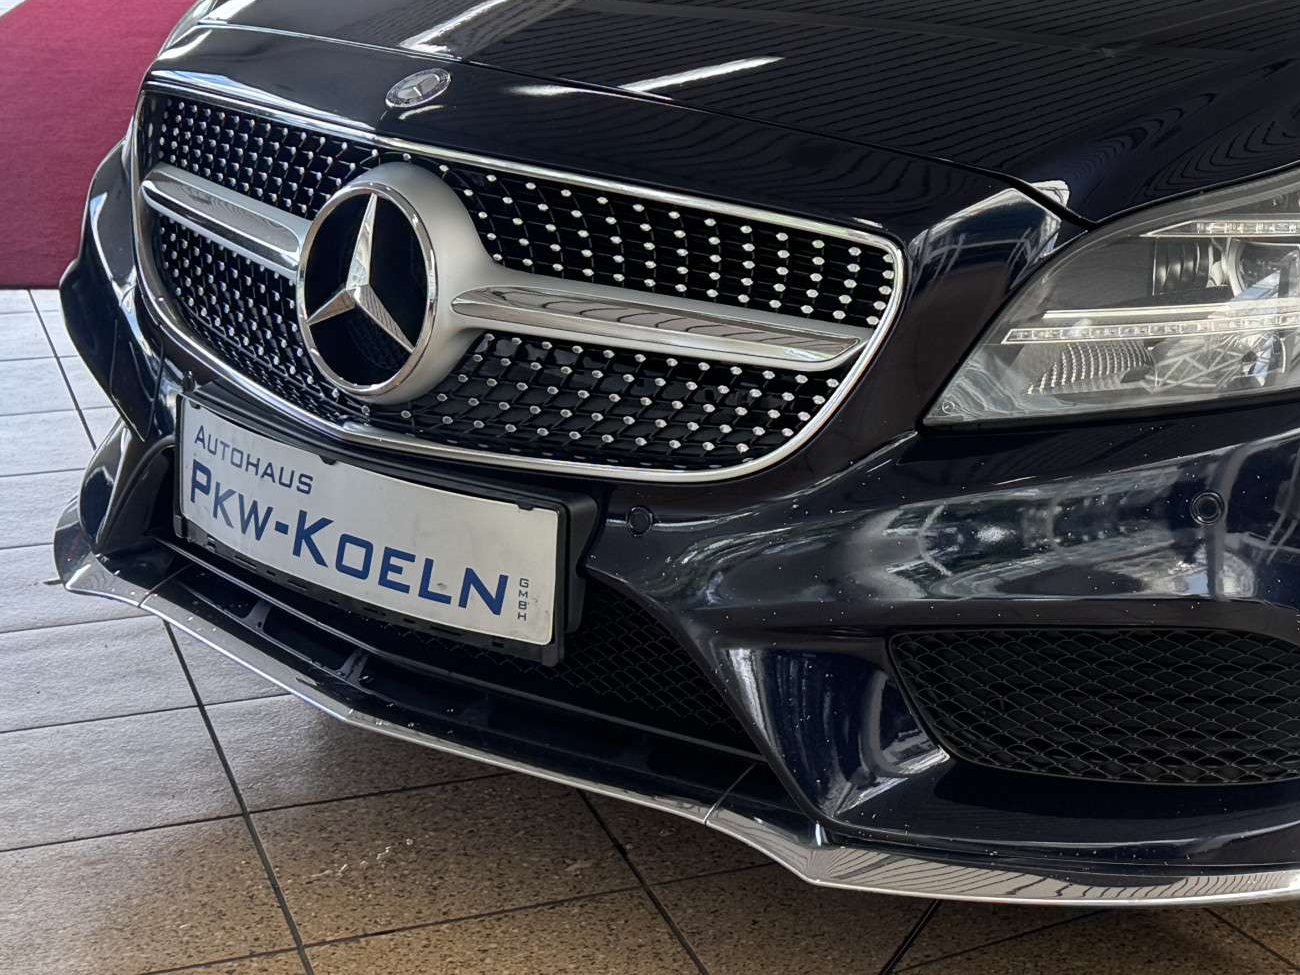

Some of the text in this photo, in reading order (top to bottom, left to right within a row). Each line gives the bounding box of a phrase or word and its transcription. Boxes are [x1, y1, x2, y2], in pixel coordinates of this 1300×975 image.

[194, 425, 314, 495] AUTOHAUS
[190, 459, 509, 616] PKW-KOELN
[517, 577, 529, 621] GMBH
